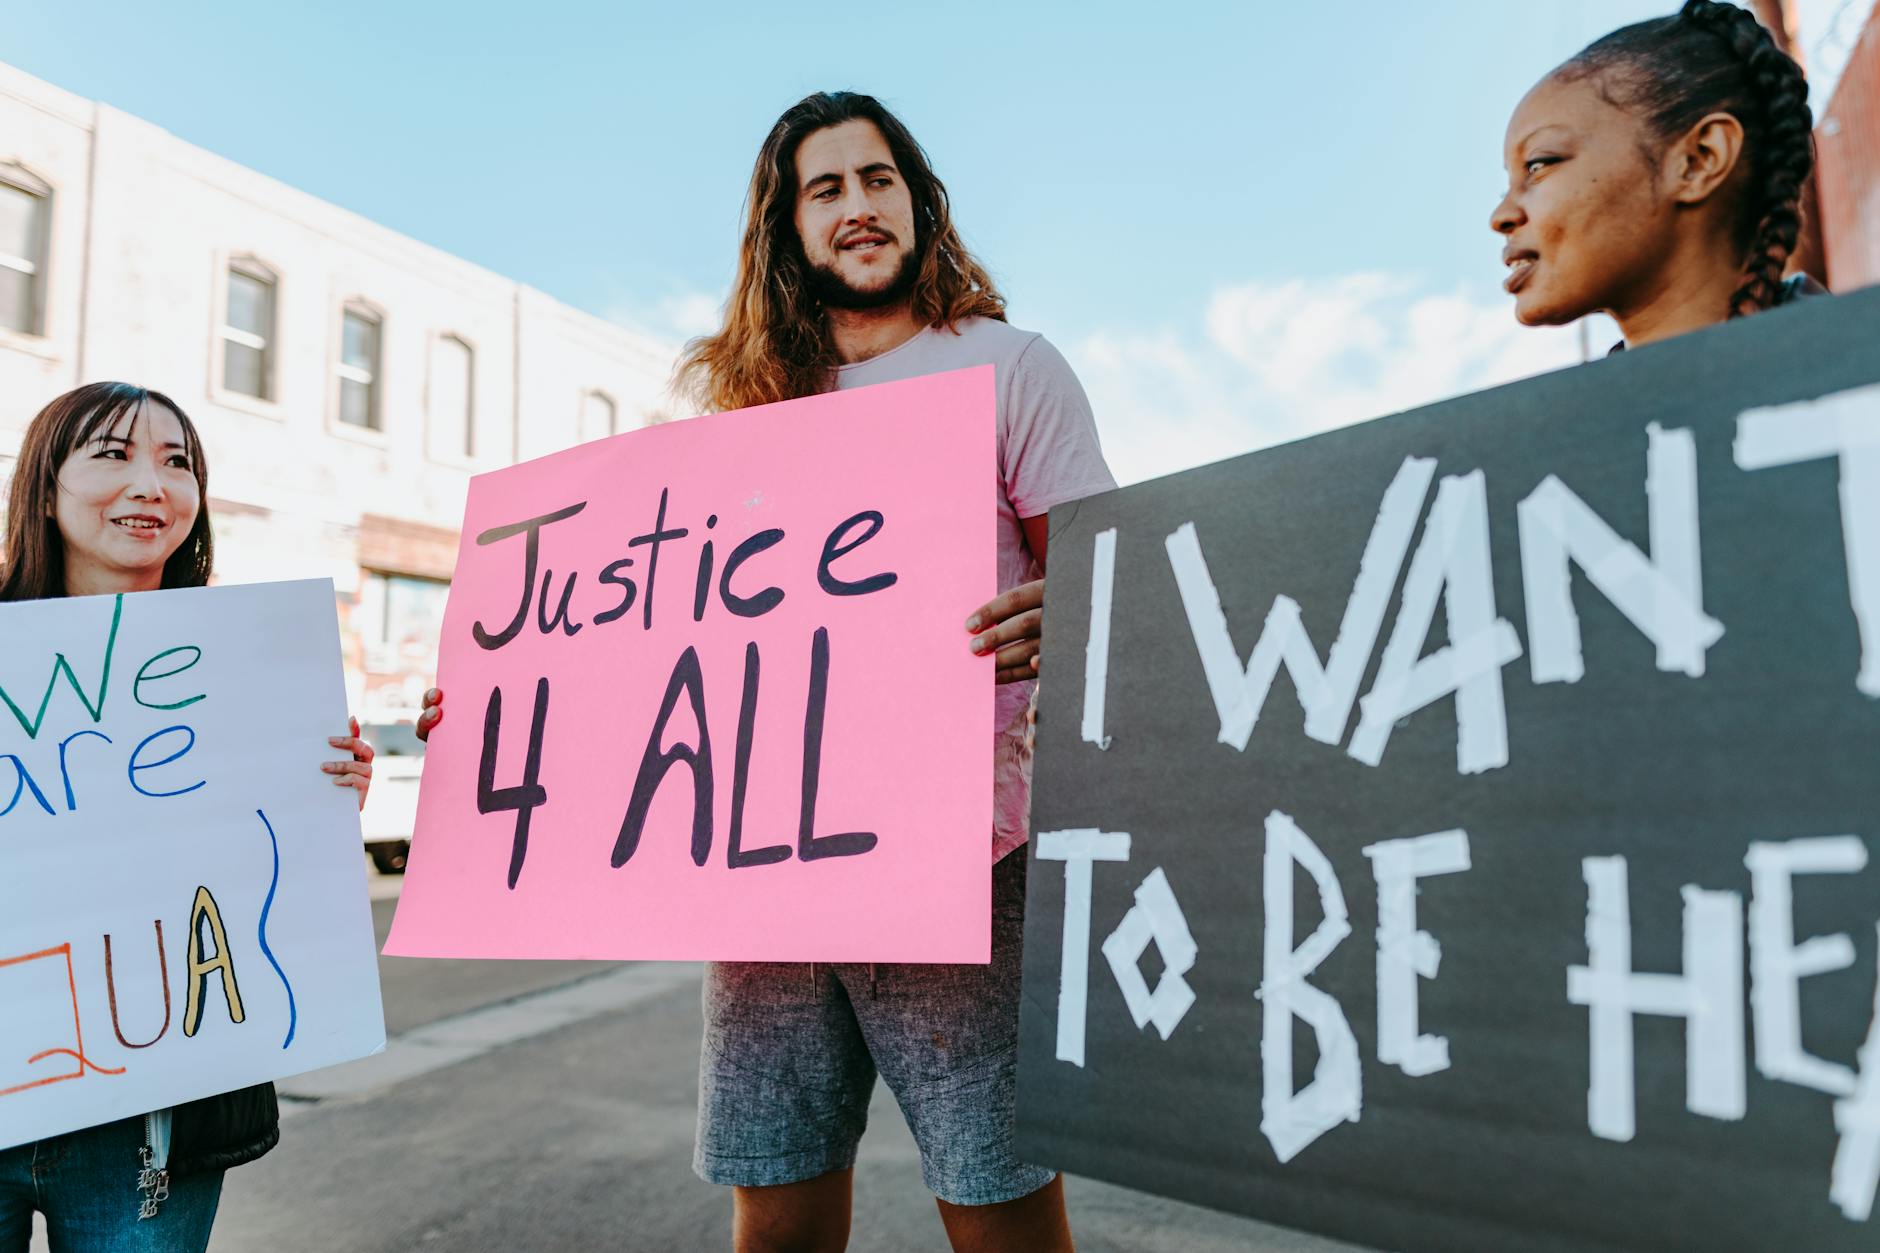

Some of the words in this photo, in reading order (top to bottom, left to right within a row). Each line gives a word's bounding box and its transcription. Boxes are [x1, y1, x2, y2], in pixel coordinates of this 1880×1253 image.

[0, 592, 206, 739] We
[472, 487, 898, 650] Justice
[1082, 527, 1117, 751] I
[477, 677, 549, 890] 4
[611, 626, 878, 869] ALL
[1035, 828, 1198, 1068] TO
[1254, 810, 1471, 1164] BE
